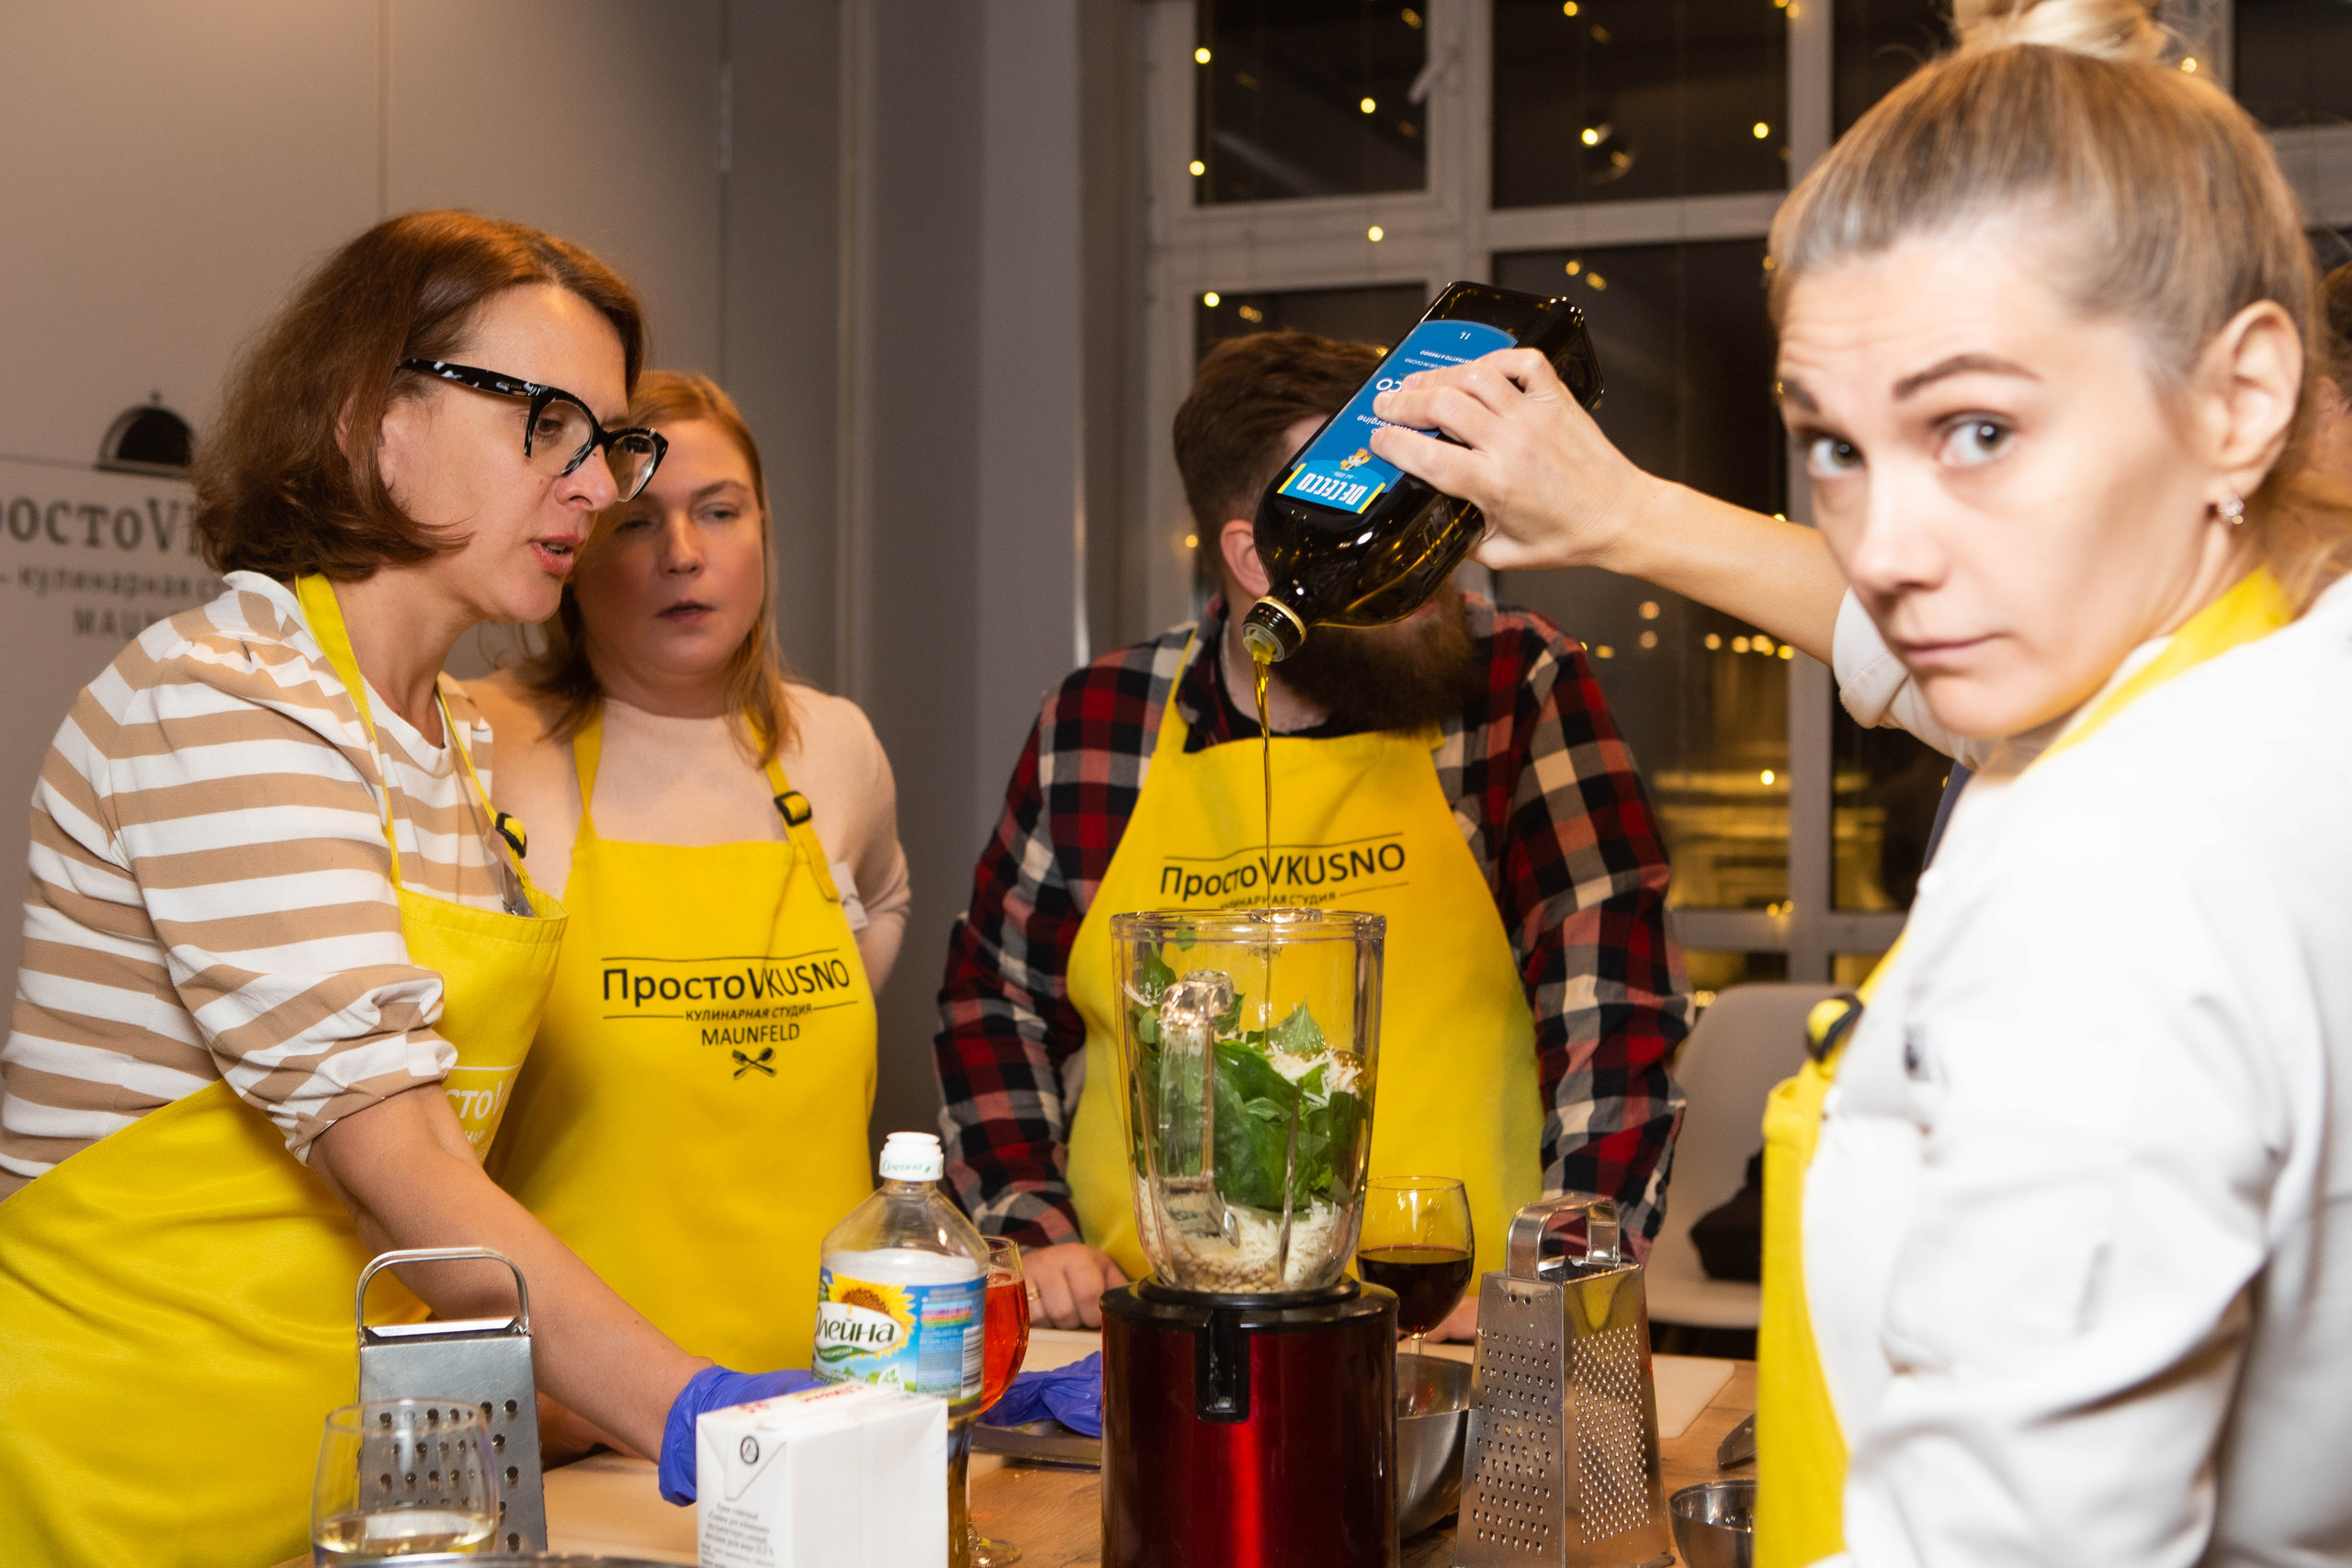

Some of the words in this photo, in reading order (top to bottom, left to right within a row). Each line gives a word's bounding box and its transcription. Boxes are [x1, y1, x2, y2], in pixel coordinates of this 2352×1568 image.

[1419, 350, 1441, 359] FREDDO
[1296, 472, 1348, 501] CECCO
[1339, 483, 1368, 505] DE
[603, 958, 850, 1008] ПростоVKUSNO
[685, 1008, 770, 1021] КУЛИНАРНАЯ
[772, 1003, 813, 1019] СТУДИЯ
[701, 1022, 800, 1046] MAUNFELD
